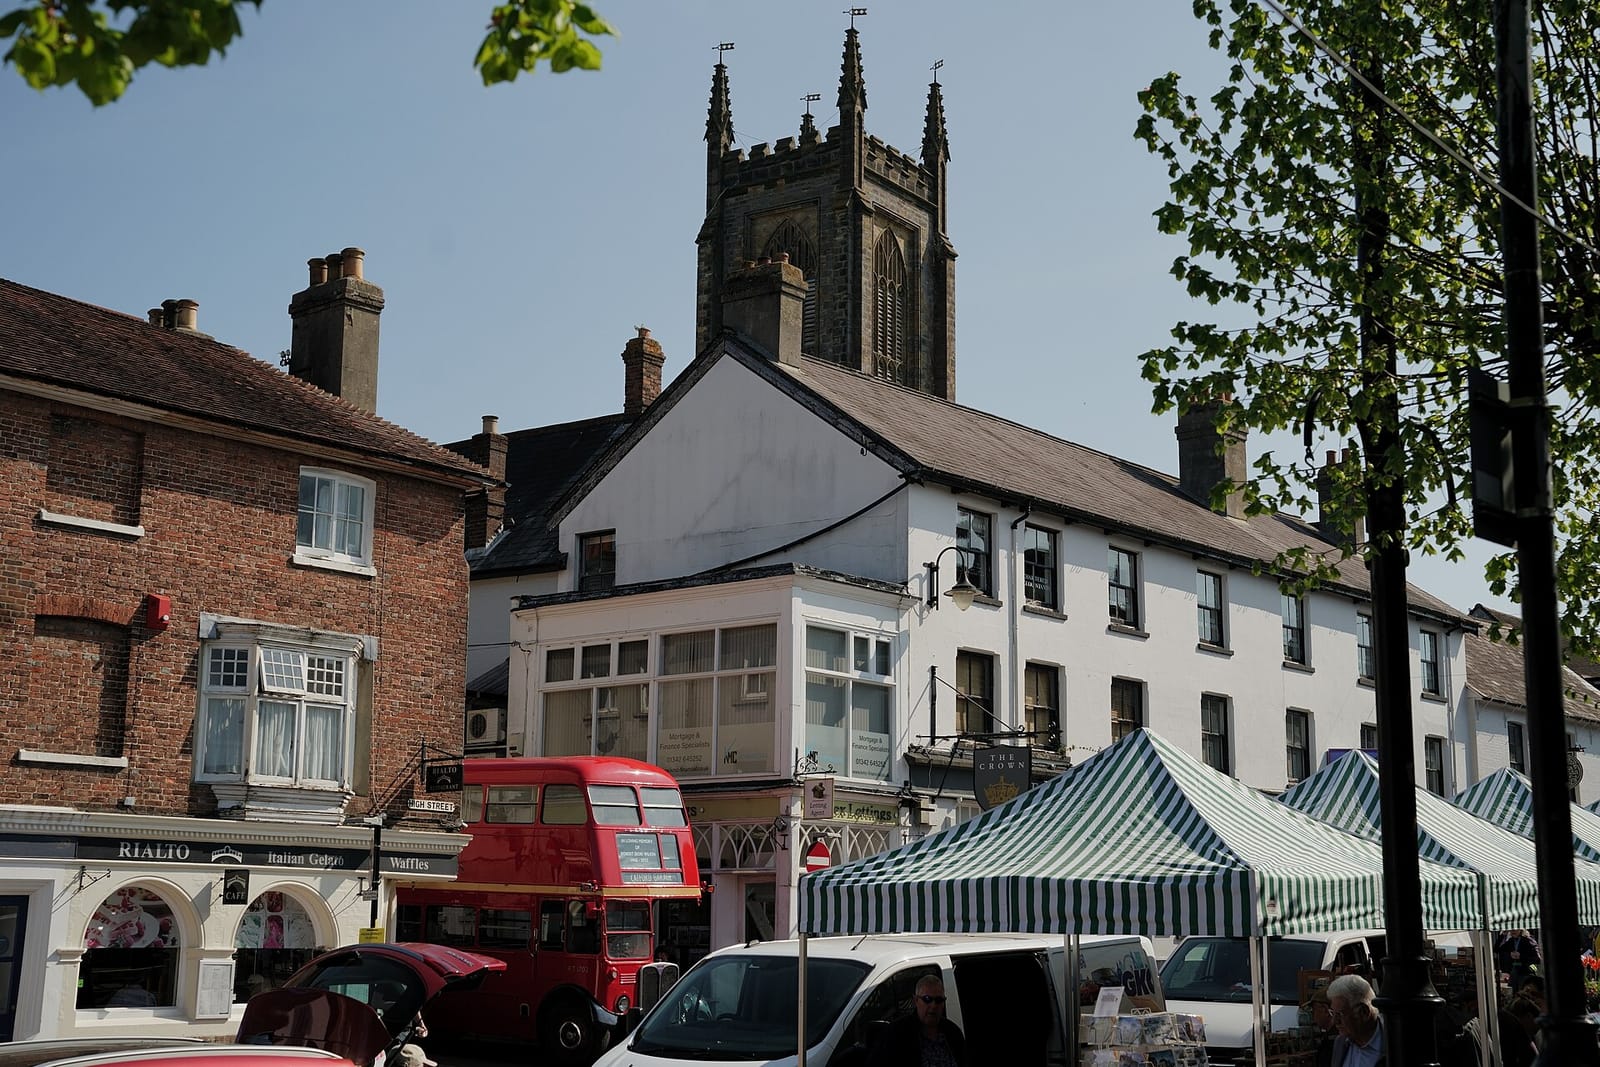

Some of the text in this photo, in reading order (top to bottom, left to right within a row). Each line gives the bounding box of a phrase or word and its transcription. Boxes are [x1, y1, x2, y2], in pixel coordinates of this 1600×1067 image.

[669, 732, 695, 741] Mortgage
[859, 735, 878, 744] Mortgage
[659, 742, 680, 750] Finance
[852, 742, 868, 750] Finance
[432, 766, 457, 775] RIALTO
[979, 762, 1025, 770] CROWN
[408, 799, 454, 811] HIGH STREET
[847, 803, 892, 822] Lettings
[118, 841, 190, 860] RIALTO
[268, 851, 344, 867] Italian Gelato
[390, 856, 429, 871] Waffles
